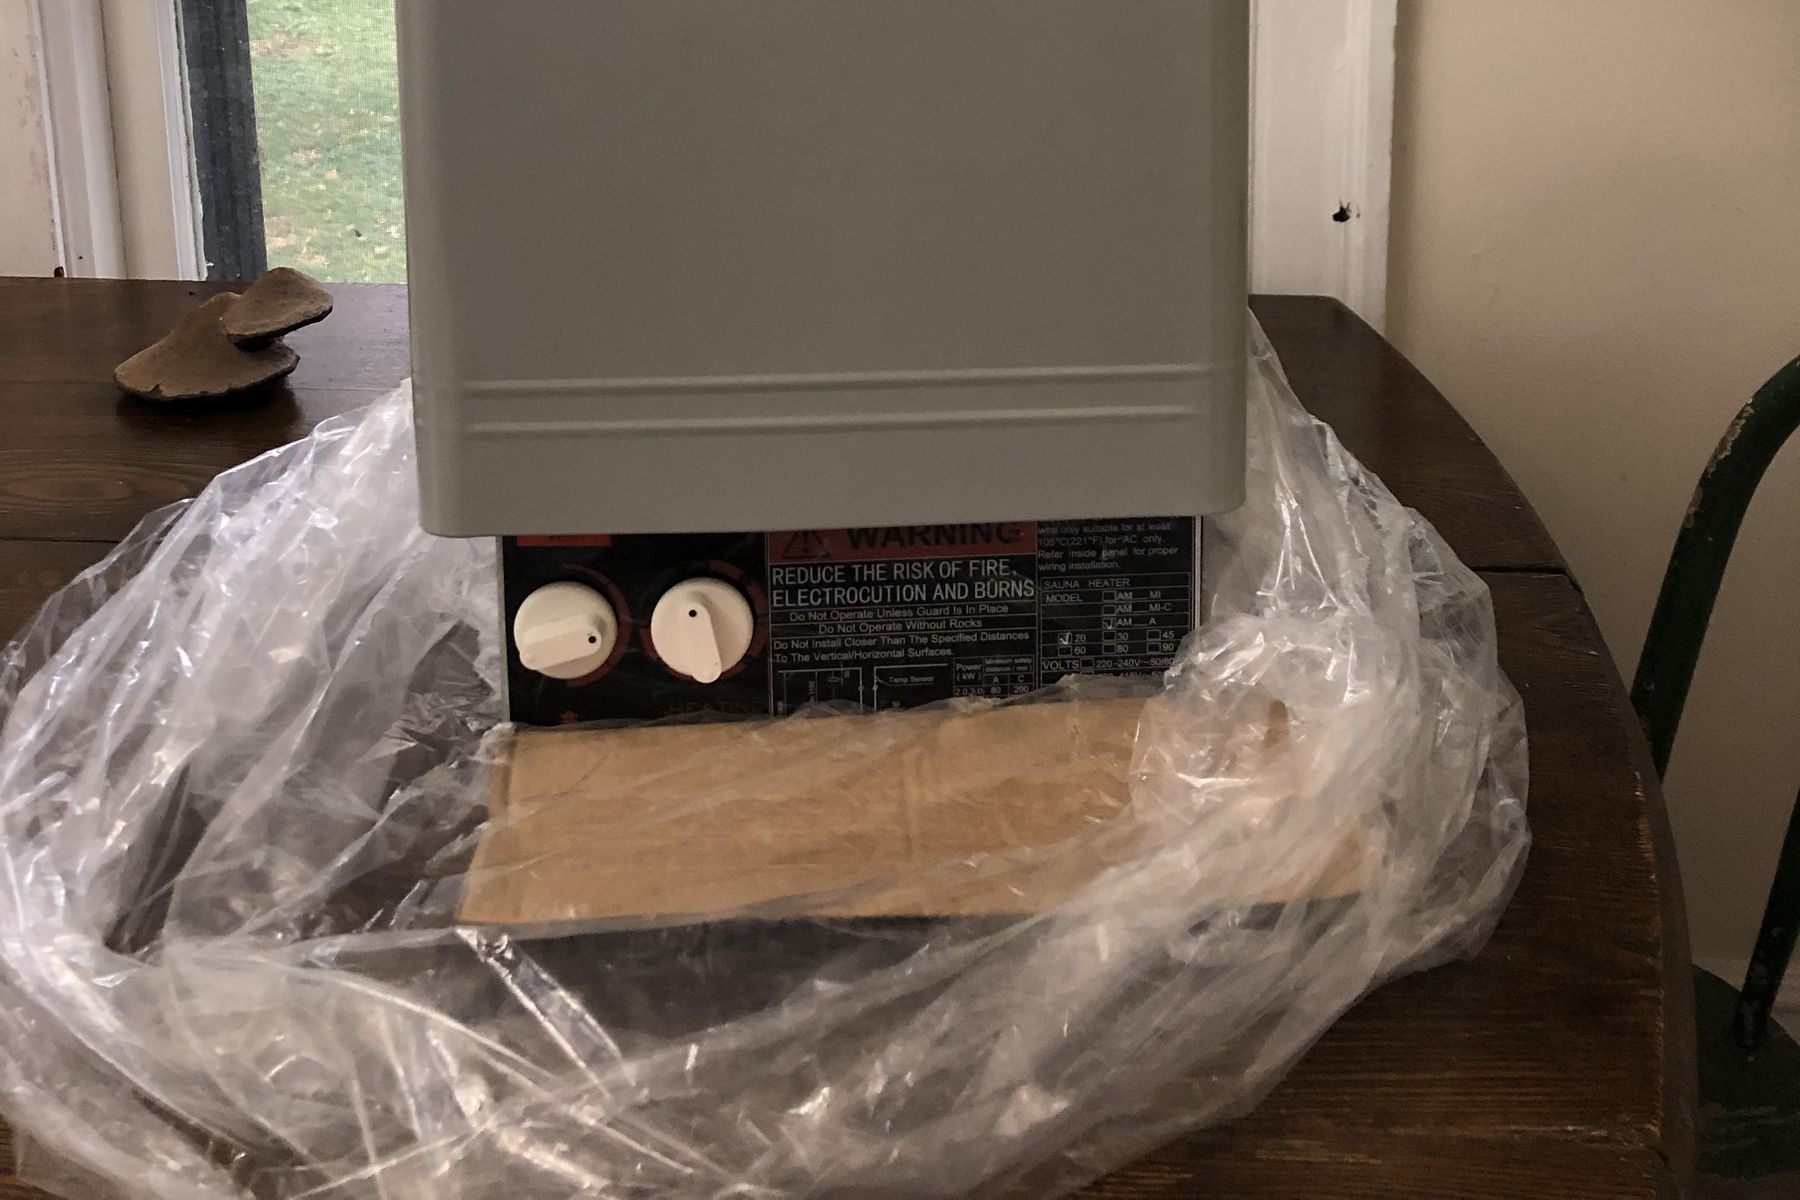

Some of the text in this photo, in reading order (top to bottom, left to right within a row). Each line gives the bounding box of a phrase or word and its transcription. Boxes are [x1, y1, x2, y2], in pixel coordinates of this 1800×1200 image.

[847, 523, 1022, 549] WARNING
[1122, 535, 1138, 544] AC
[1039, 550, 1063, 559] Refer
[1069, 549, 1096, 558] inside
[1133, 546, 1146, 556] for
[1148, 547, 1179, 557] proper
[772, 559, 1017, 586] REDUCE THE RISK OF FIRE,
[1039, 561, 1067, 572] wiring
[1044, 578, 1131, 590] SAUNA HEATER
[772, 579, 1035, 607] ELECTROCUTION AND BURNS
[1046, 592, 1082, 603] MODEL
[790, 603, 1009, 622] Do Not Operate Unless Guard Is In Place
[819, 618, 983, 634] Do Not Operate Without Rocks
[773, 631, 1030, 650] Do Not Install Closer Than The Specified Distances
[1074, 630, 1175, 643] 20 30 45
[1162, 642, 1175, 651] 90
[775, 653, 788, 663] To
[791, 652, 811, 662] The
[956, 662, 982, 671] Power
[1042, 660, 1080, 670] VOLTS
